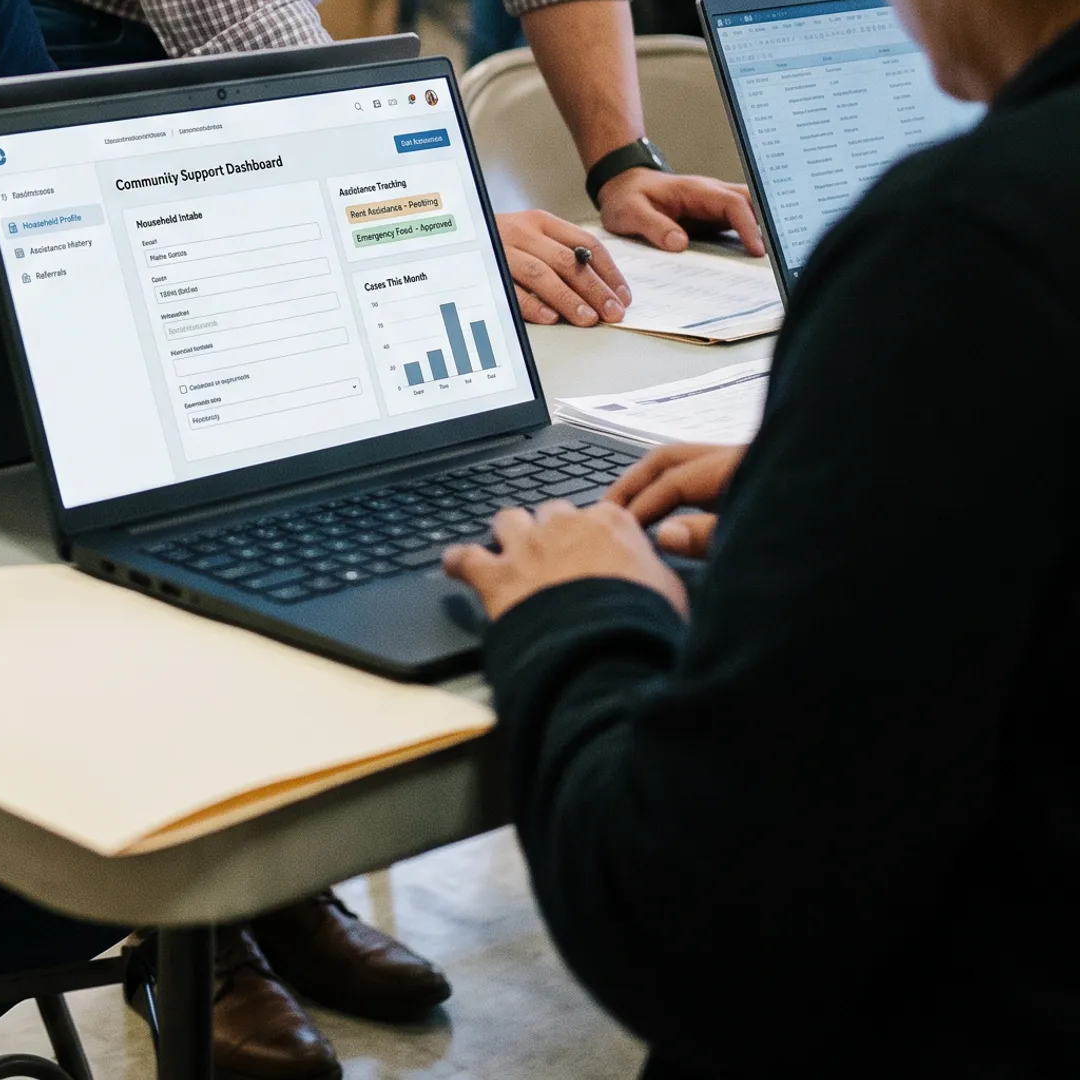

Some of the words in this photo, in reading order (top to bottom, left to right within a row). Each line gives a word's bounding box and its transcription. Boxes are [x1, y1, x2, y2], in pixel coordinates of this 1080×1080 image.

[115, 171, 179, 191] Community
[180, 165, 224, 183] Support
[225, 154, 284, 175] Dashboard
[349, 209, 367, 219] Rent
[356, 230, 395, 243] Emergency
[420, 219, 453, 232] Approved
[363, 281, 387, 292] Cases
[386, 276, 402, 287] This
[403, 272, 428, 284] Month
